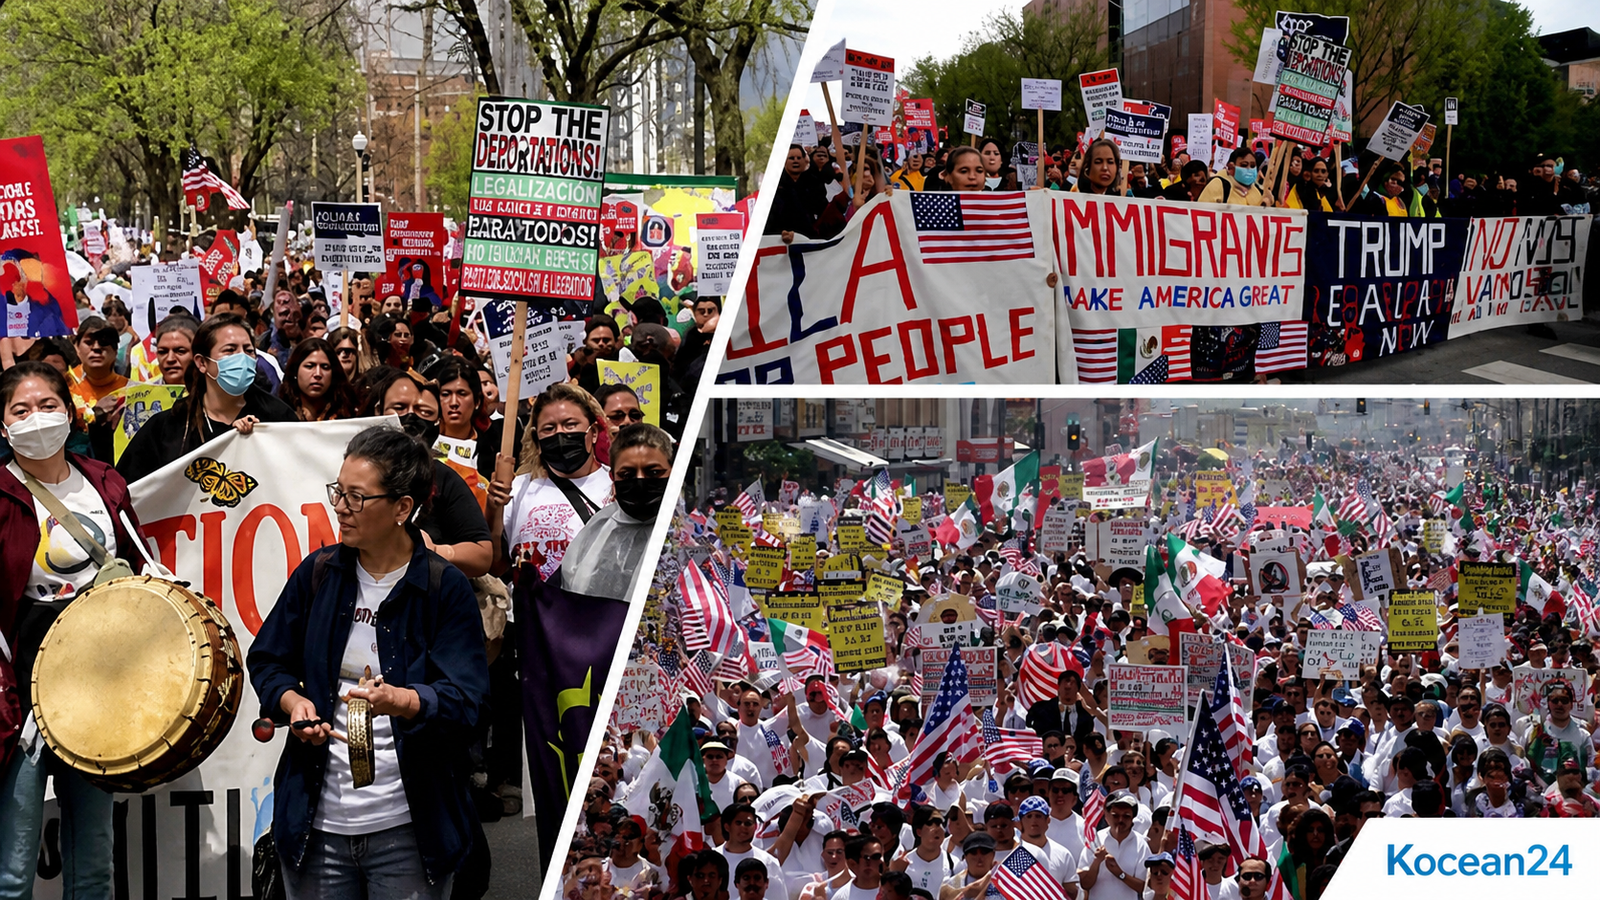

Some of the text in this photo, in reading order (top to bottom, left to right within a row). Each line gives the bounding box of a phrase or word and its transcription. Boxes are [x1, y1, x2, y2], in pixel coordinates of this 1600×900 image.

[1322, 42, 1349, 67] THE
[479, 103, 603, 141] STOP THE
[473, 175, 598, 204] LEGALIZACIÓN
[467, 215, 517, 241] PARA
[1051, 198, 1304, 278] IMMIGRANTS
[1327, 219, 1446, 279] TRUMP
[1138, 285, 1235, 311] AMERICA
[1239, 284, 1296, 308] GREAT
[814, 306, 1036, 385] PEOPLE
[140, 502, 342, 637] TIO
